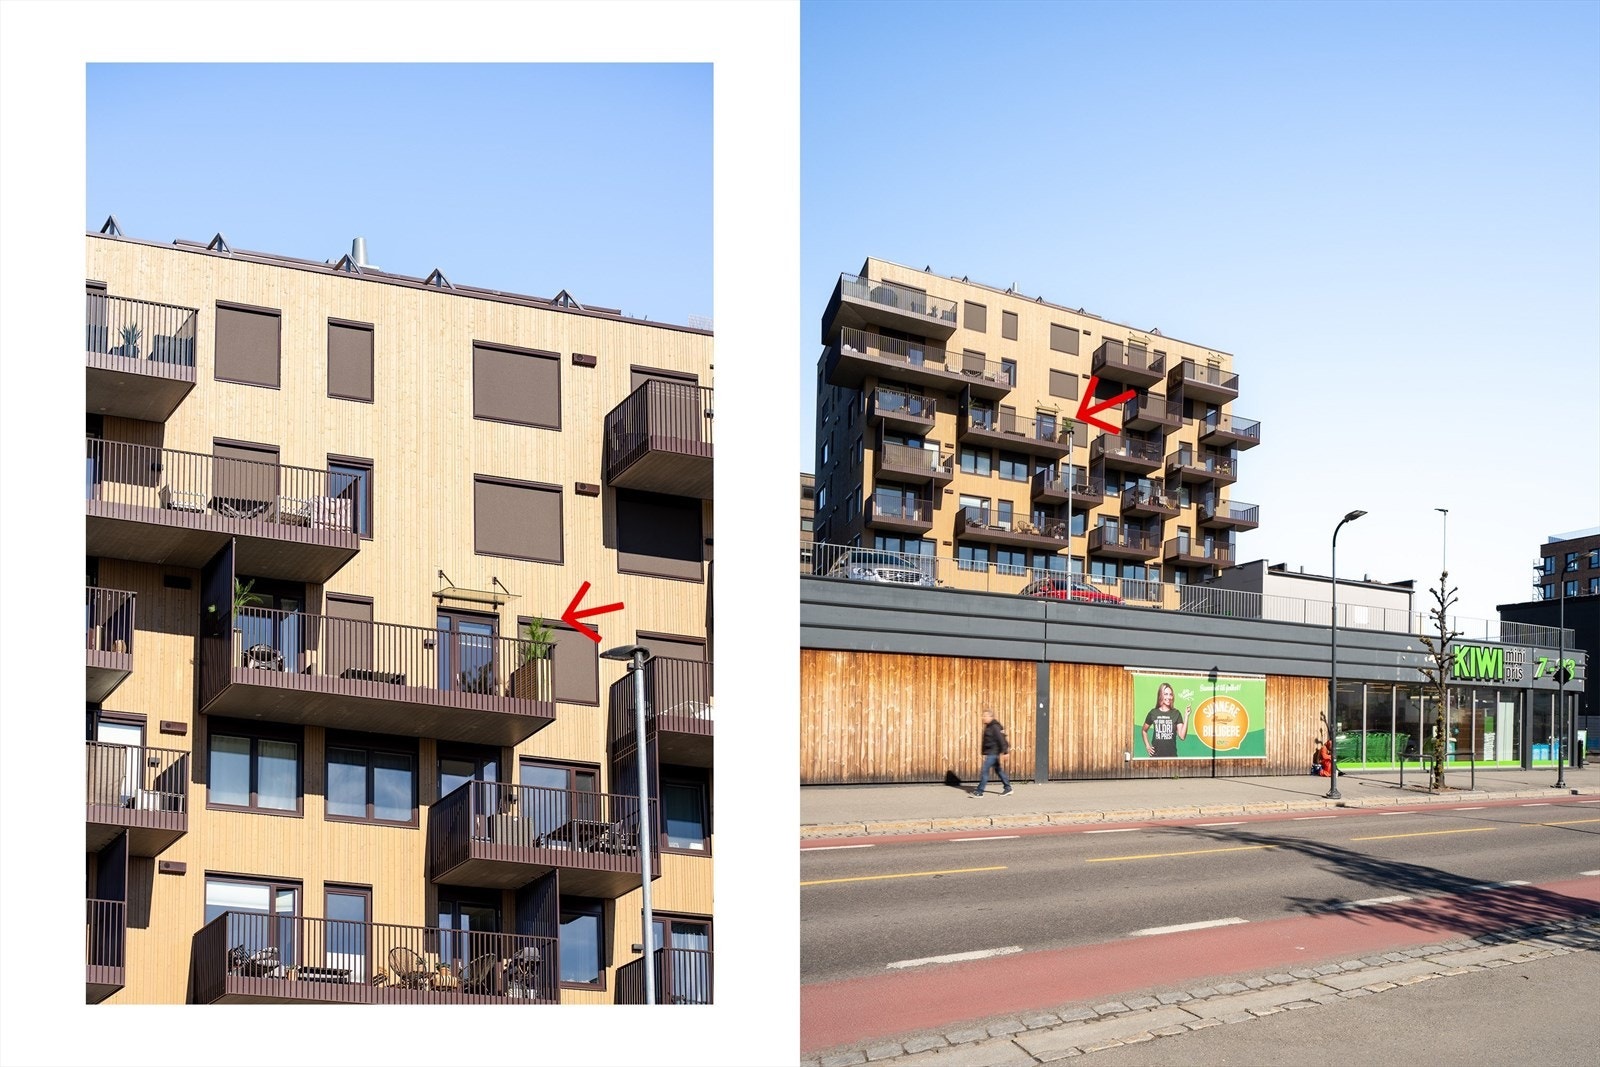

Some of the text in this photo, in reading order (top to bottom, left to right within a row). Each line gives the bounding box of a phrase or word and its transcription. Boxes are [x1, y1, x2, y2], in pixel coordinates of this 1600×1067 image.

[1453, 644, 1503, 680] KIWI
[1505, 648, 1526, 663] mini
[1505, 664, 1523, 682] pris
